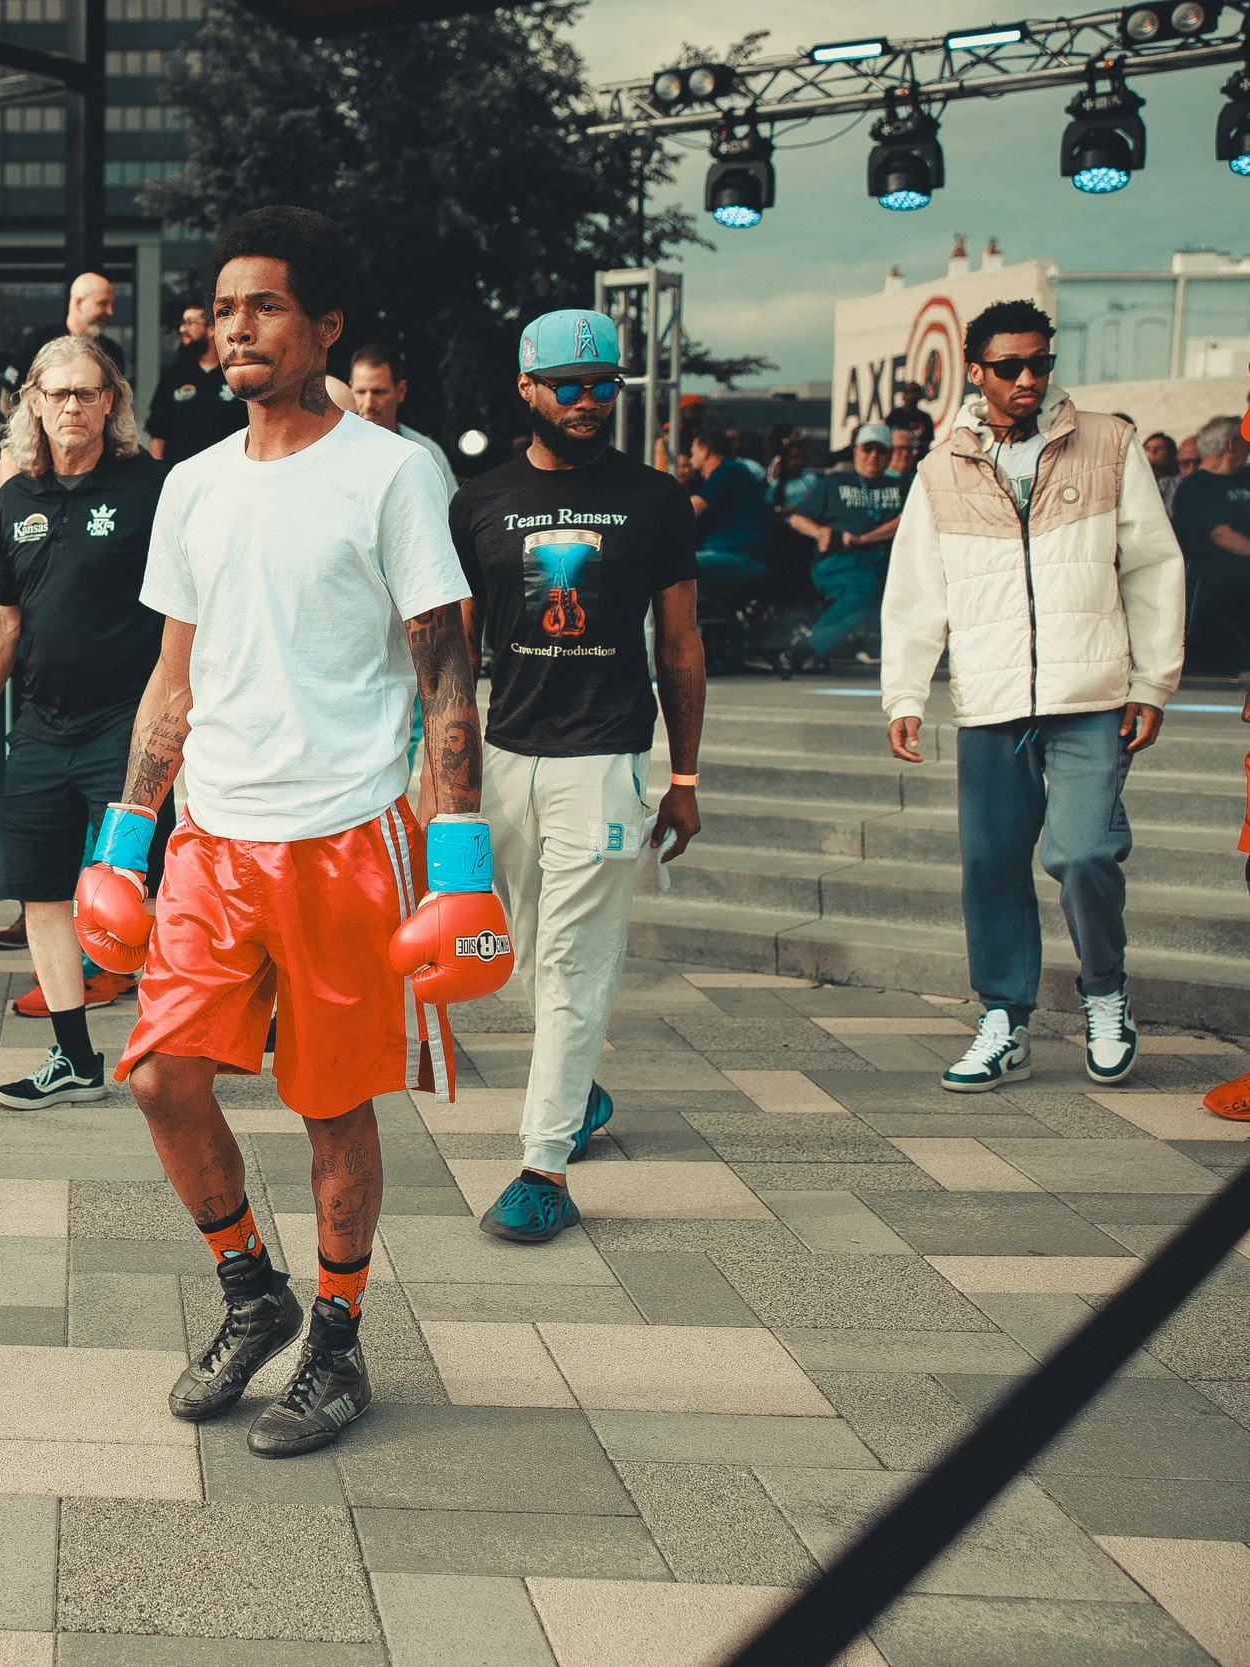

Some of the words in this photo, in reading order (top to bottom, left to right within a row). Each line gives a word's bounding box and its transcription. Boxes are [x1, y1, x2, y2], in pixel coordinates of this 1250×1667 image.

[504, 513, 553, 531] Team
[557, 508, 628, 526] Ransaw
[13, 521, 49, 538] Kansas
[510, 642, 553, 657] Crowned
[553, 645, 616, 658] Productions
[458, 938, 476, 955] SIDE
[322, 1393, 356, 1426] TITLE
